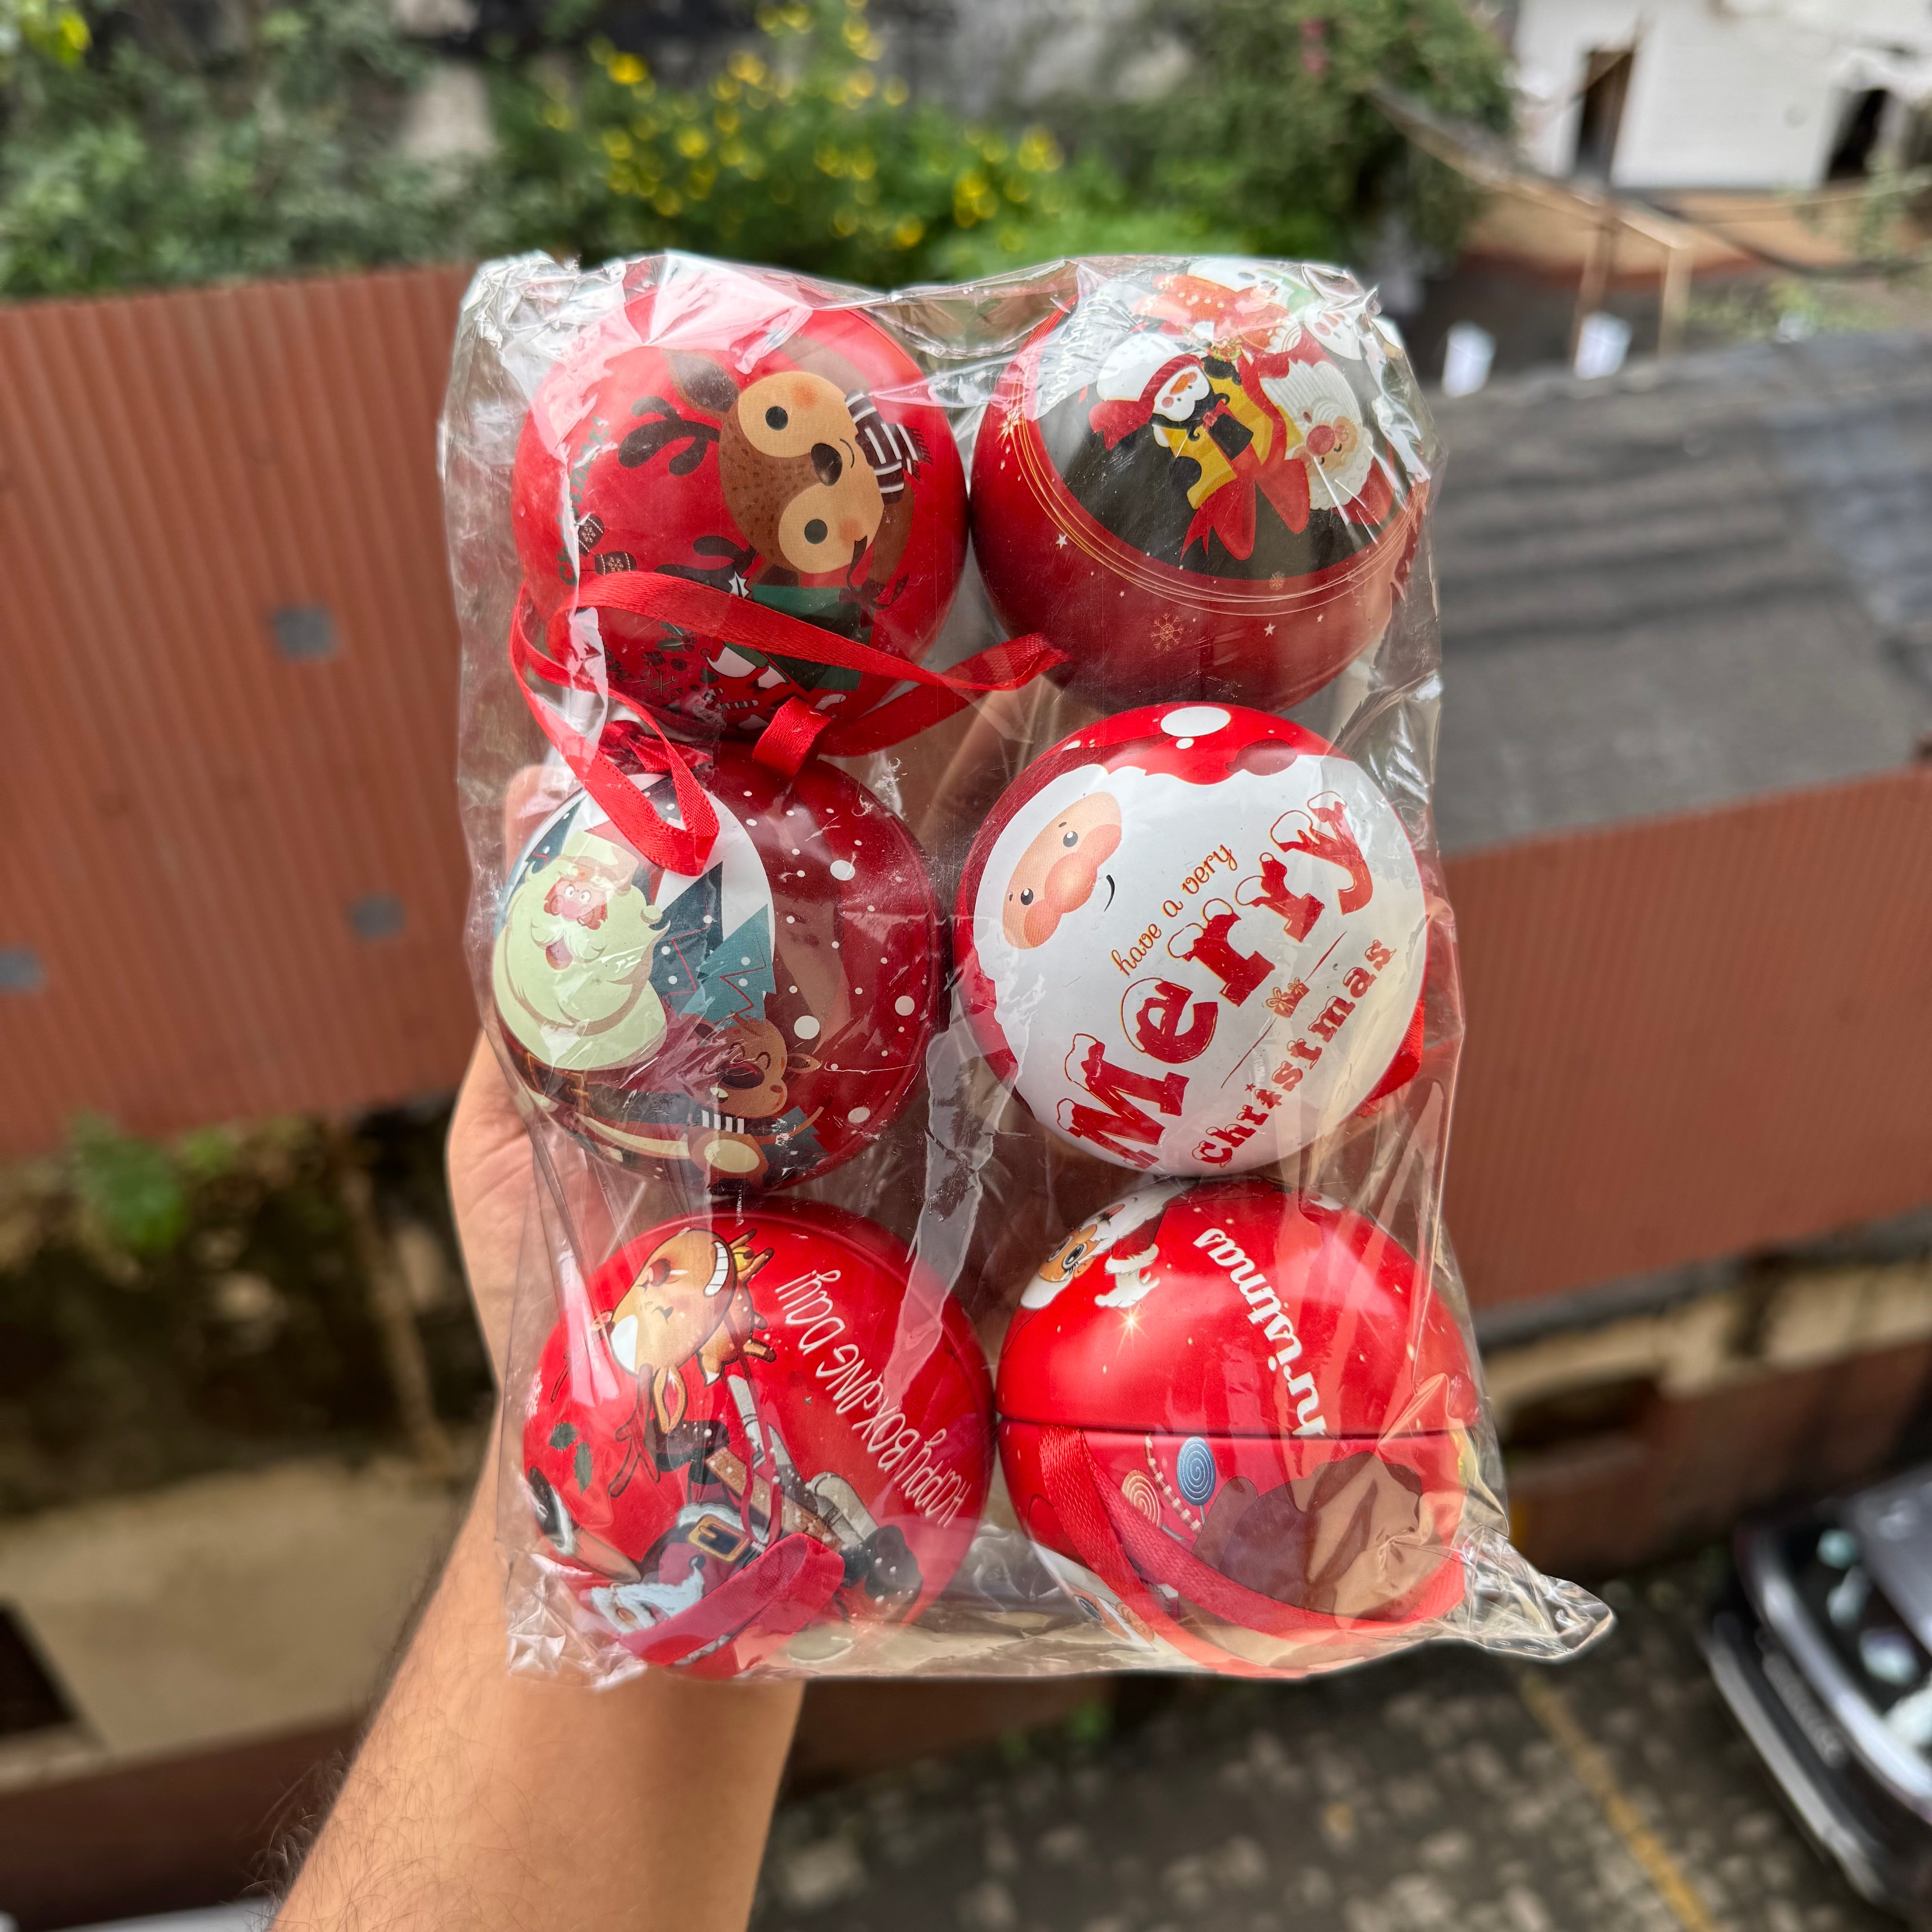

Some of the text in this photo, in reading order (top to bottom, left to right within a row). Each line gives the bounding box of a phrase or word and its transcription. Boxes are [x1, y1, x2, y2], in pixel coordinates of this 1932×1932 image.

[1057, 791, 1373, 1169] Merry
[1111, 844, 1237, 977] have a very
